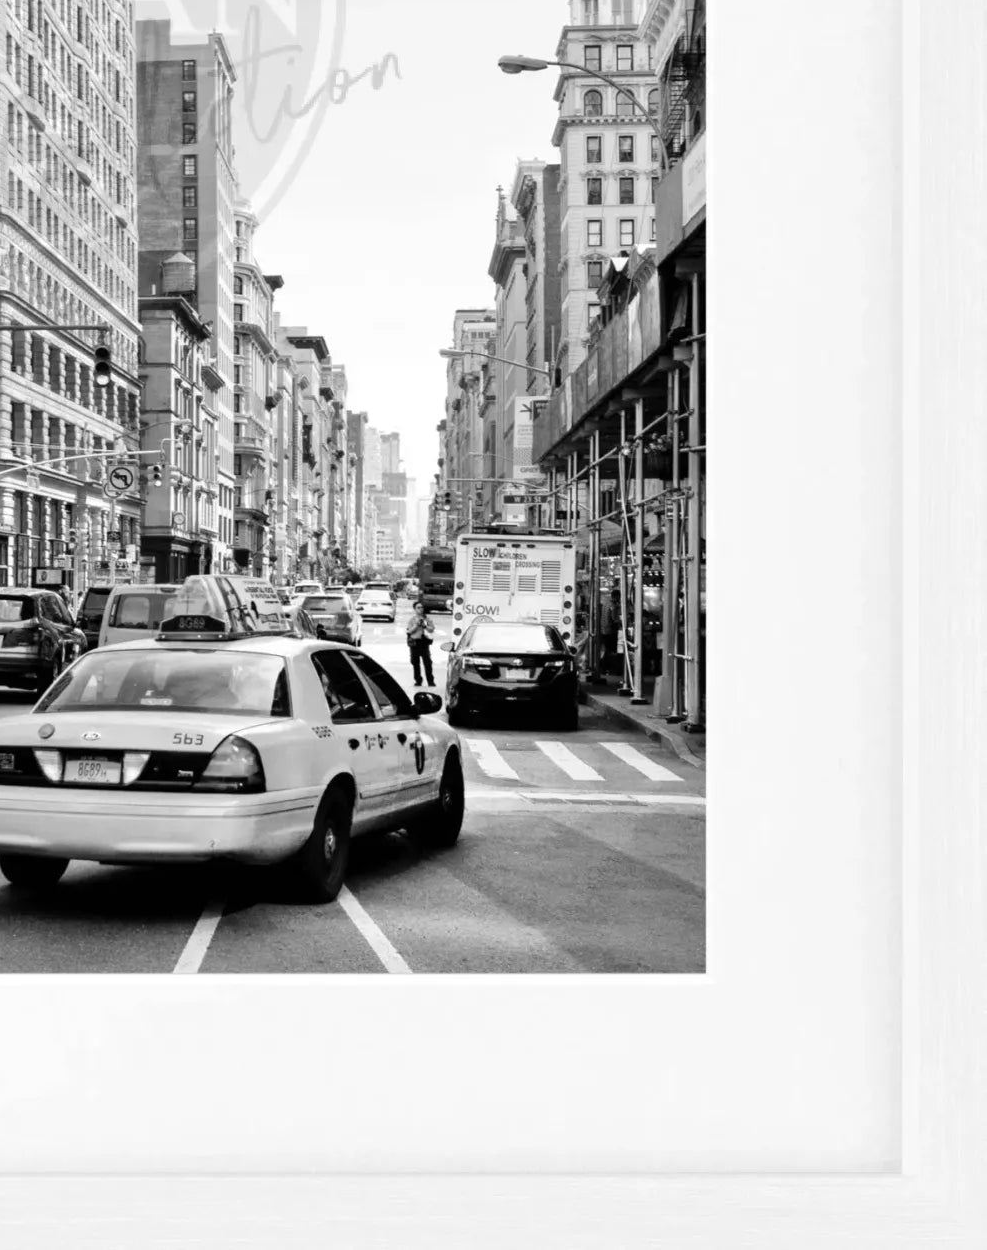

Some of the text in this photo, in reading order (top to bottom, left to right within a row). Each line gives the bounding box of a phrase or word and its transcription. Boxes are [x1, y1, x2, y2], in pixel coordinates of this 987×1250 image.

[465, 604, 500, 616] SLOW!
[178, 616, 206, 629] 8G89
[172, 733, 204, 746] 563
